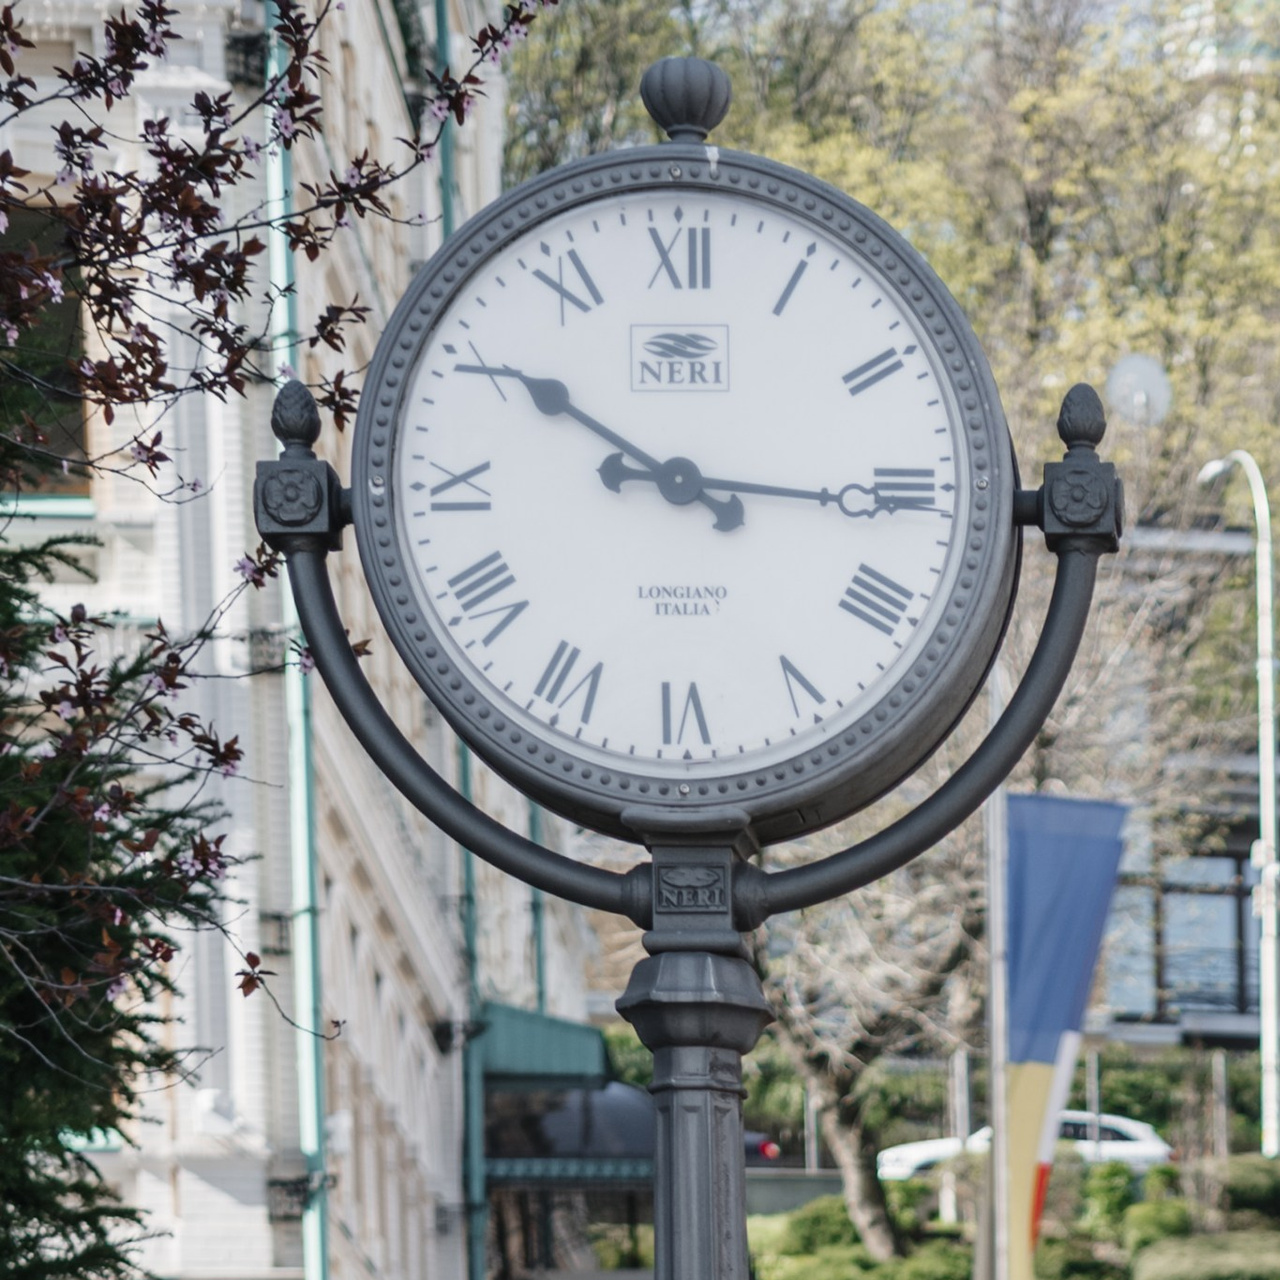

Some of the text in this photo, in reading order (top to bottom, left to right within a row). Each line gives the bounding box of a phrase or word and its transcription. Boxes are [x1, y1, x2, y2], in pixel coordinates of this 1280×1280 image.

[639, 360, 723, 384] NERI
[638, 585, 728, 600] LONGIANO
[655, 602, 711, 616] ITALIA
[660, 888, 723, 907] NERI
